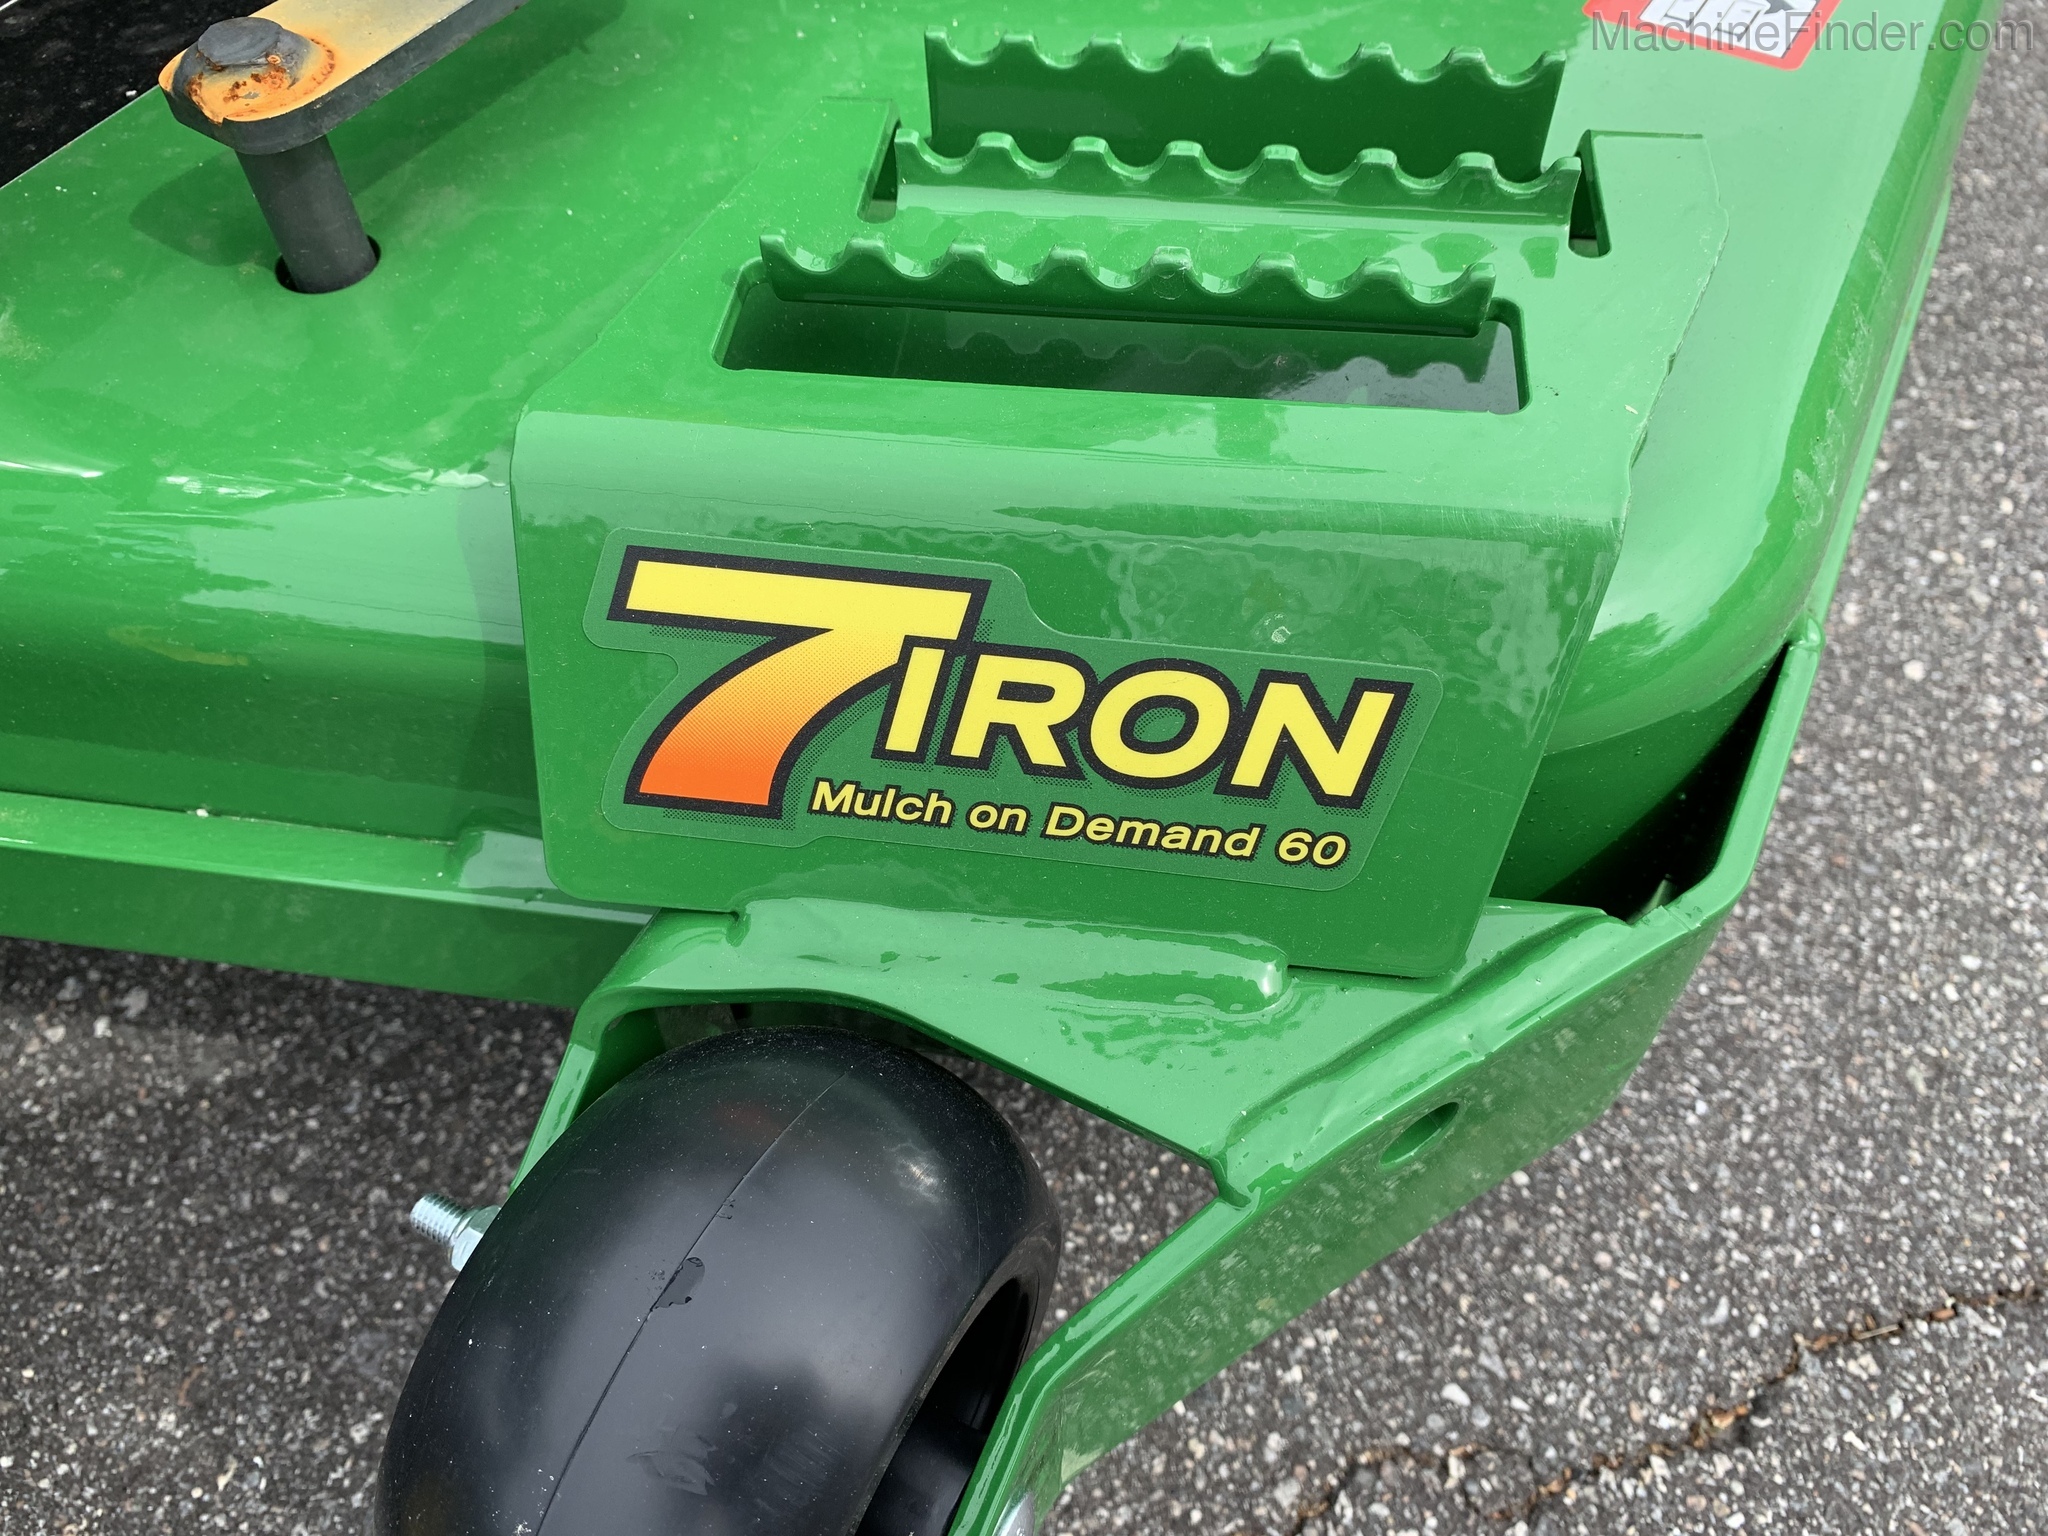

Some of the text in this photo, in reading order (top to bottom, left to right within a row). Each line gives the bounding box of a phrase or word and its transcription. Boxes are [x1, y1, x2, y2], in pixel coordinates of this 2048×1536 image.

[872, 634, 1414, 809] IRON
[810, 778, 1350, 868] Mulch on Demand 60
